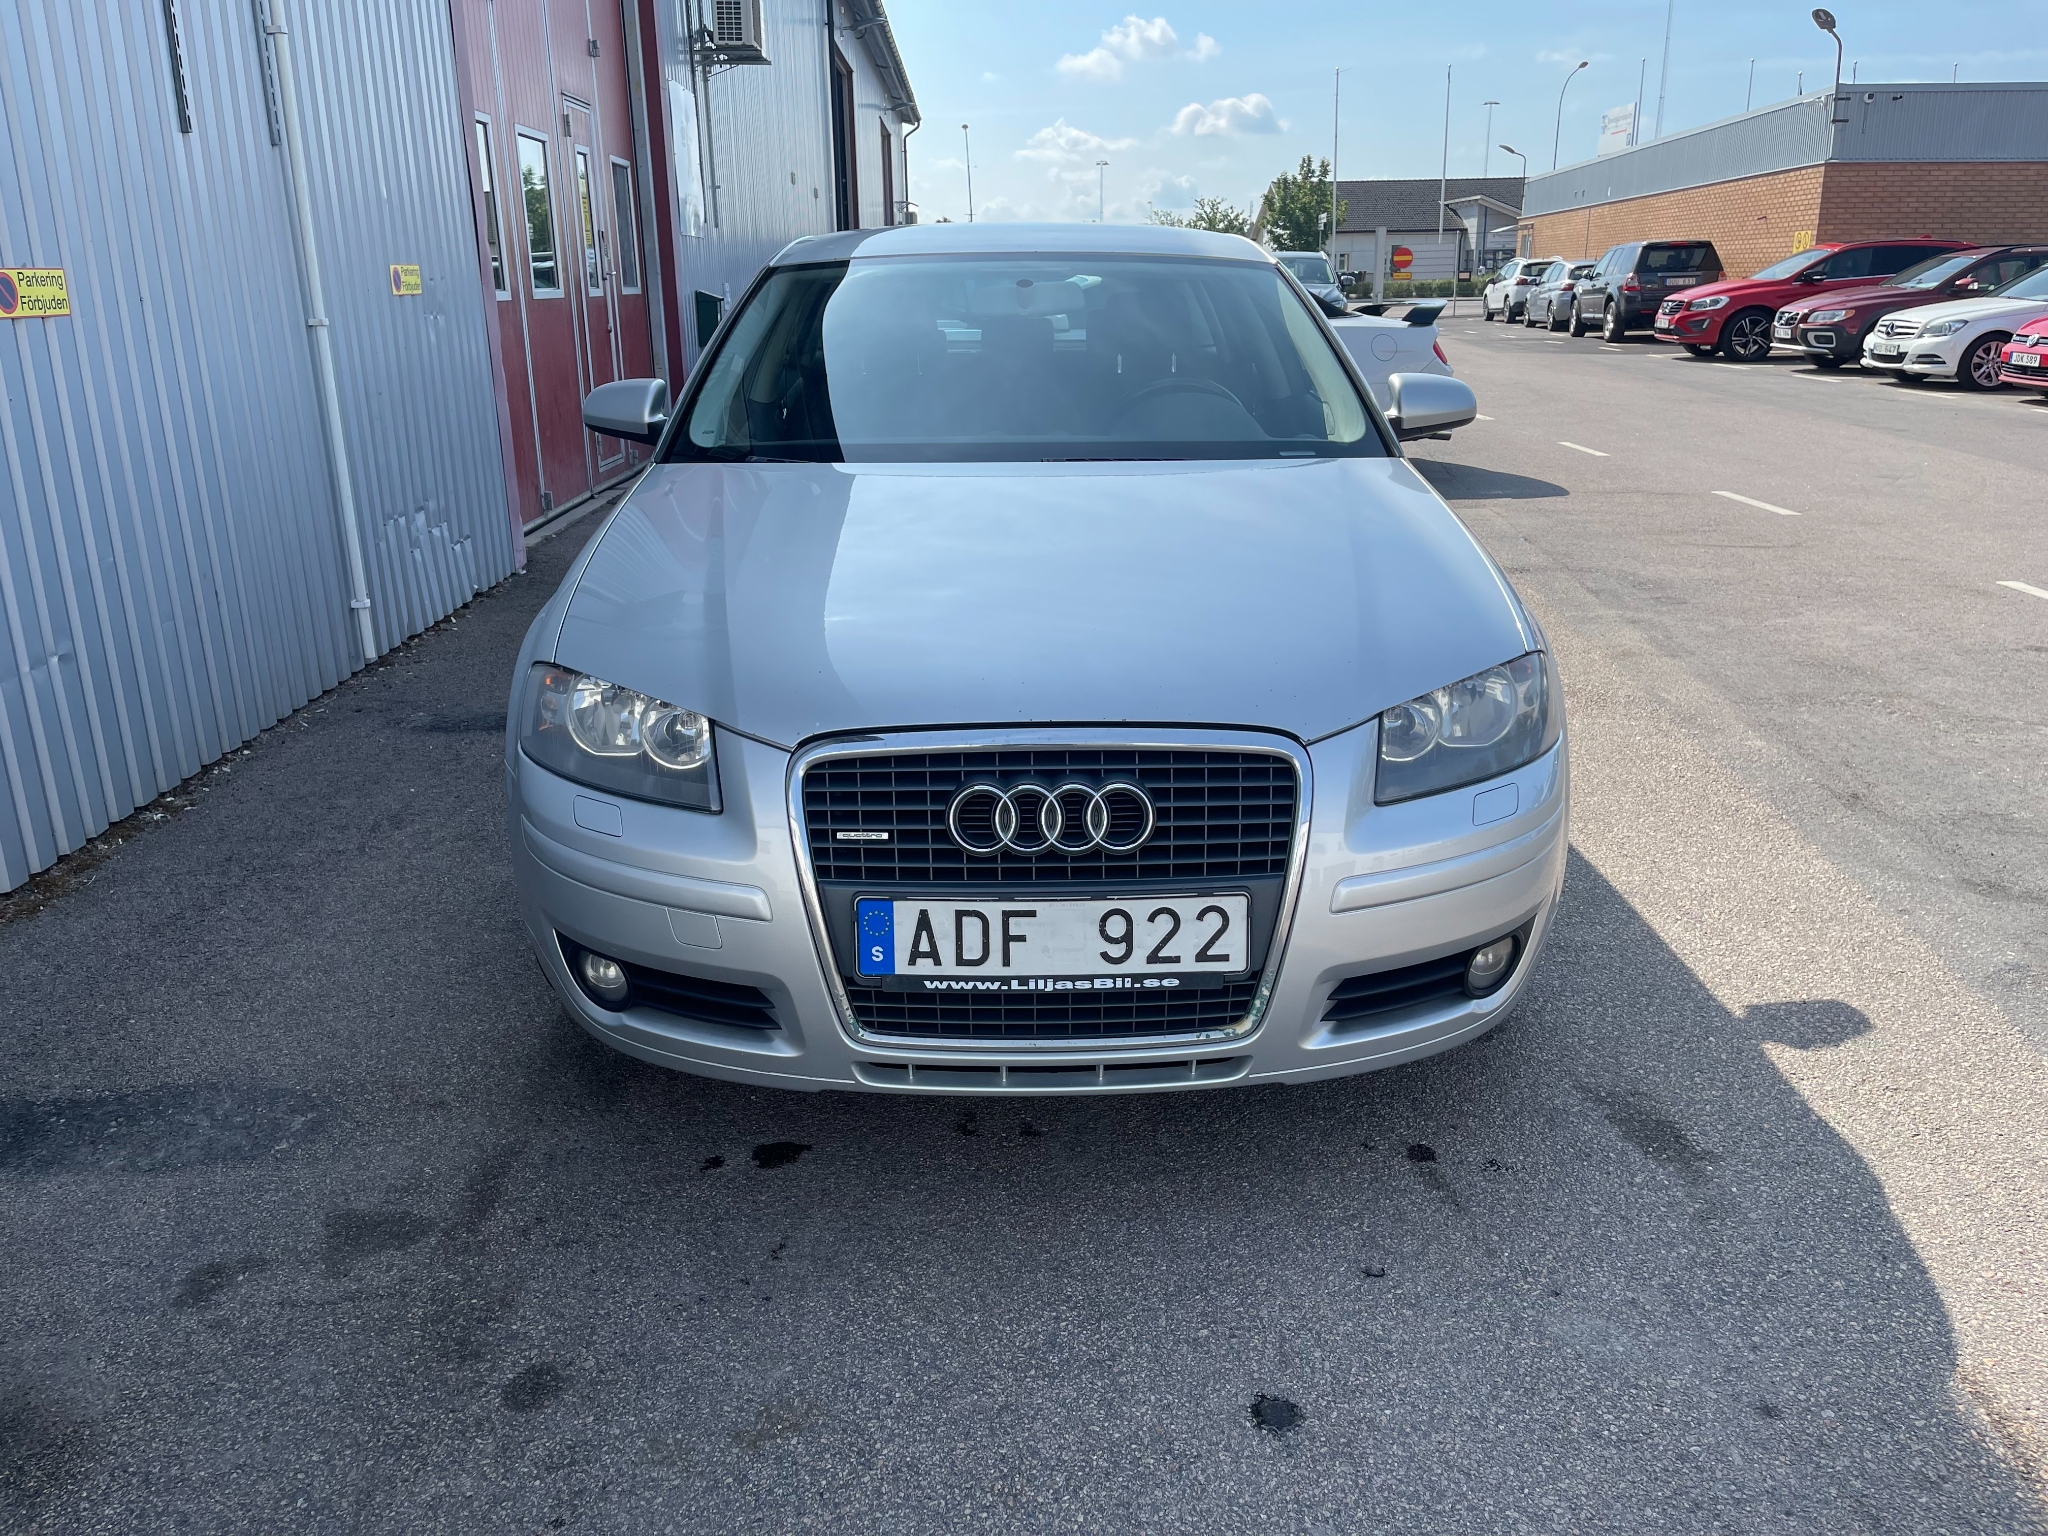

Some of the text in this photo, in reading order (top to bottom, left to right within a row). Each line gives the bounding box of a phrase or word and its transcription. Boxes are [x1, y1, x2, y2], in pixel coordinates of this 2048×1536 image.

[17, 272, 63, 290] Parkering
[20, 295, 68, 314] Förbjuden
[908, 905, 1230, 967] ADF 922
[871, 946, 884, 961] S
[923, 977, 1180, 991] www.LiljasBil.se
